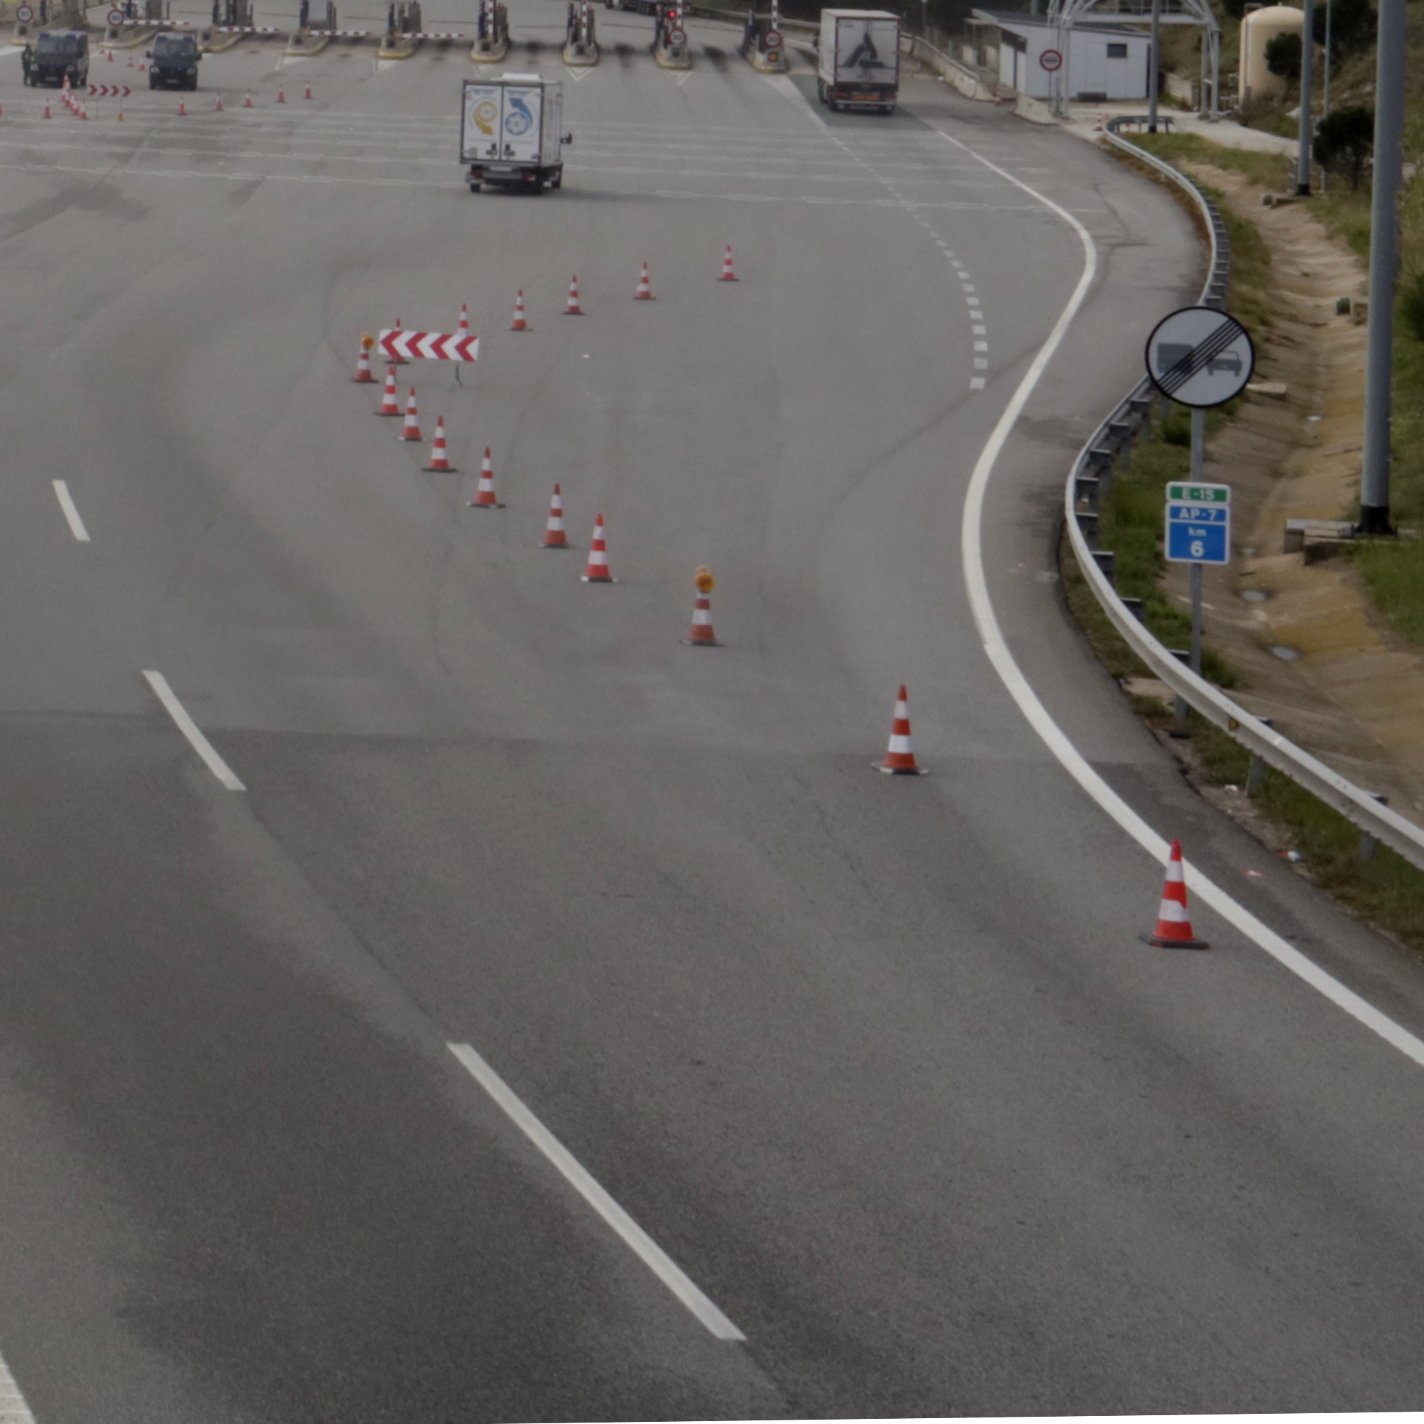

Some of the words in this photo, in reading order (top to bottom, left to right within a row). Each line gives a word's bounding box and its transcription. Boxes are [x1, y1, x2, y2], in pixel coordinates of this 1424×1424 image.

[1181, 487, 1215, 501] E-15
[1179, 508, 1217, 520] AP-7
[1188, 527, 1207, 537] km
[1190, 540, 1204, 557] 6
